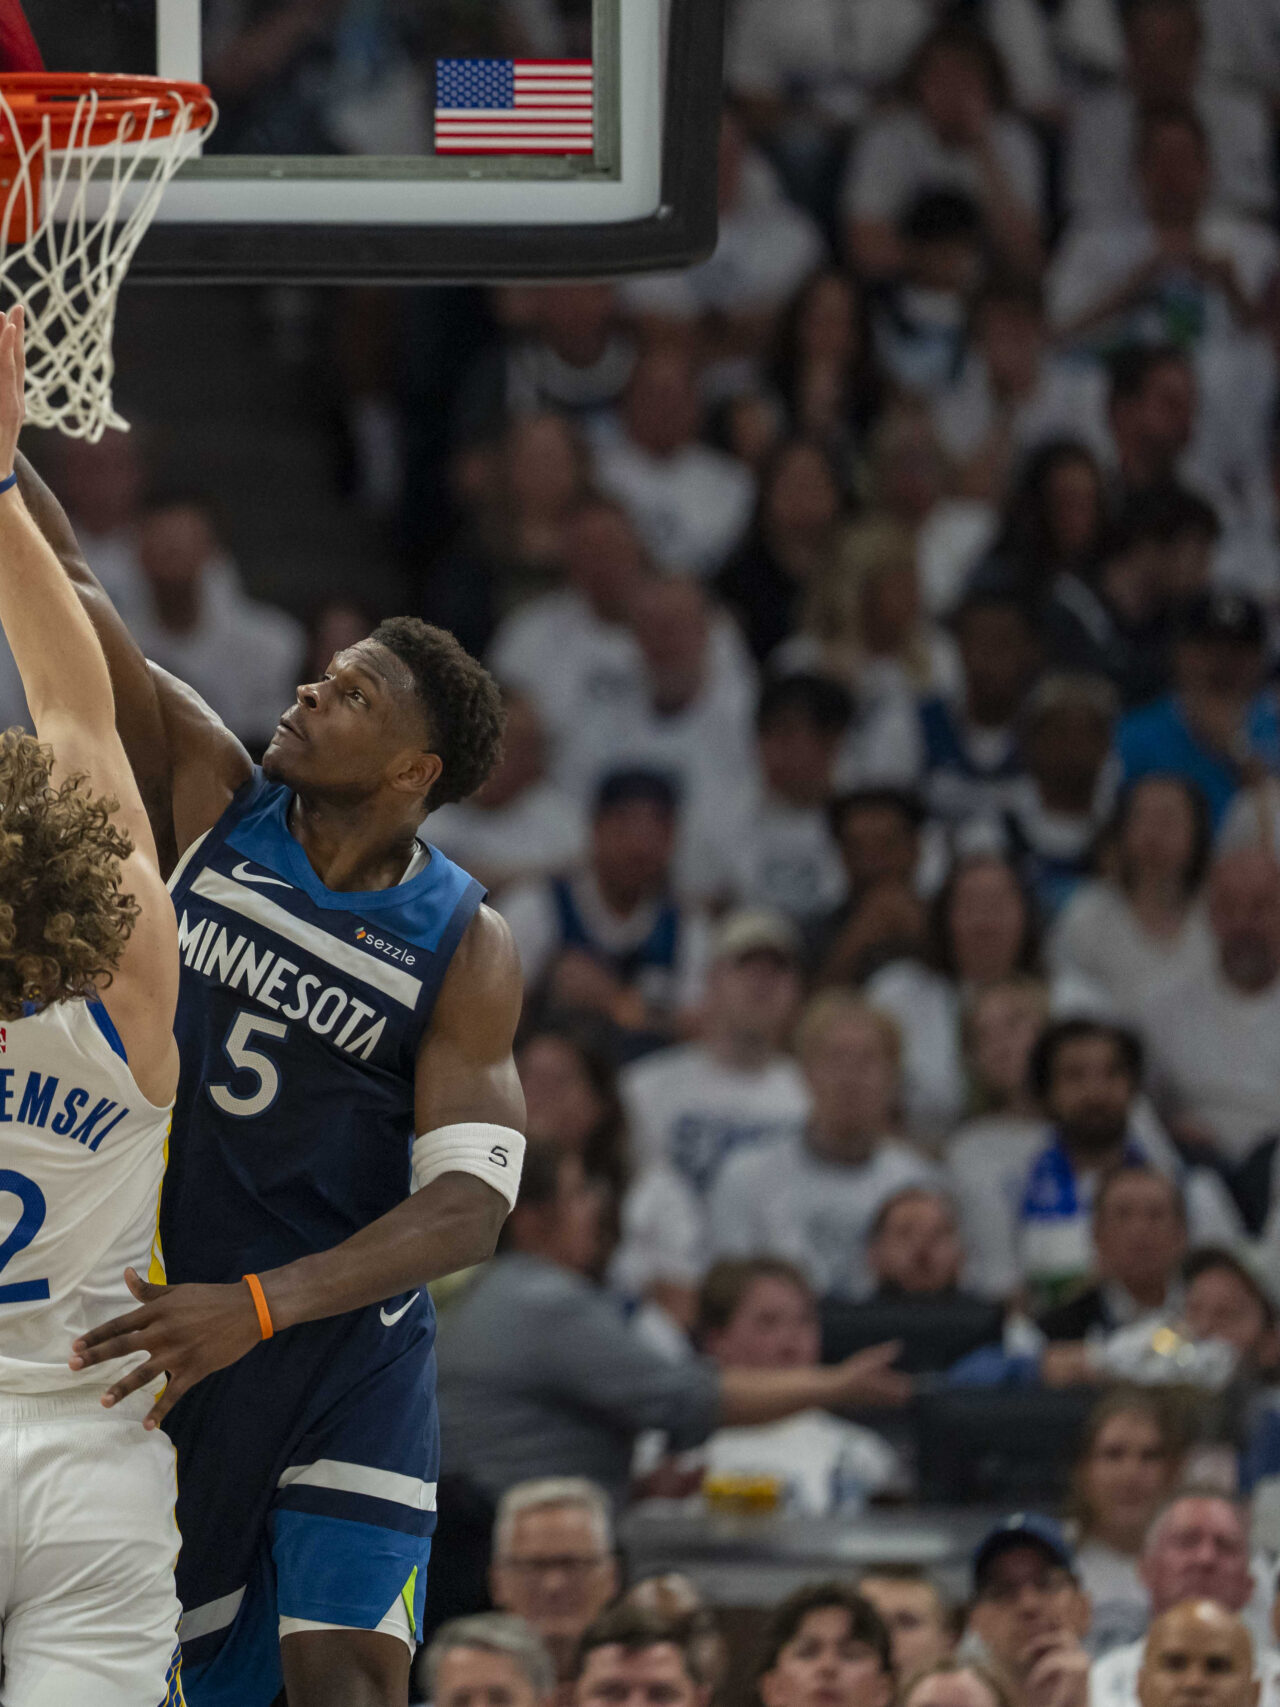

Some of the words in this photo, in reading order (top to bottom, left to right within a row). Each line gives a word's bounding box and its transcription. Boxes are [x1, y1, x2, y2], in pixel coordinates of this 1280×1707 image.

[365, 933, 416, 966] sezzle
[178, 908, 388, 1061] MINNESOTA
[208, 1010, 289, 1116] 5
[488, 1145, 509, 1168] 5
